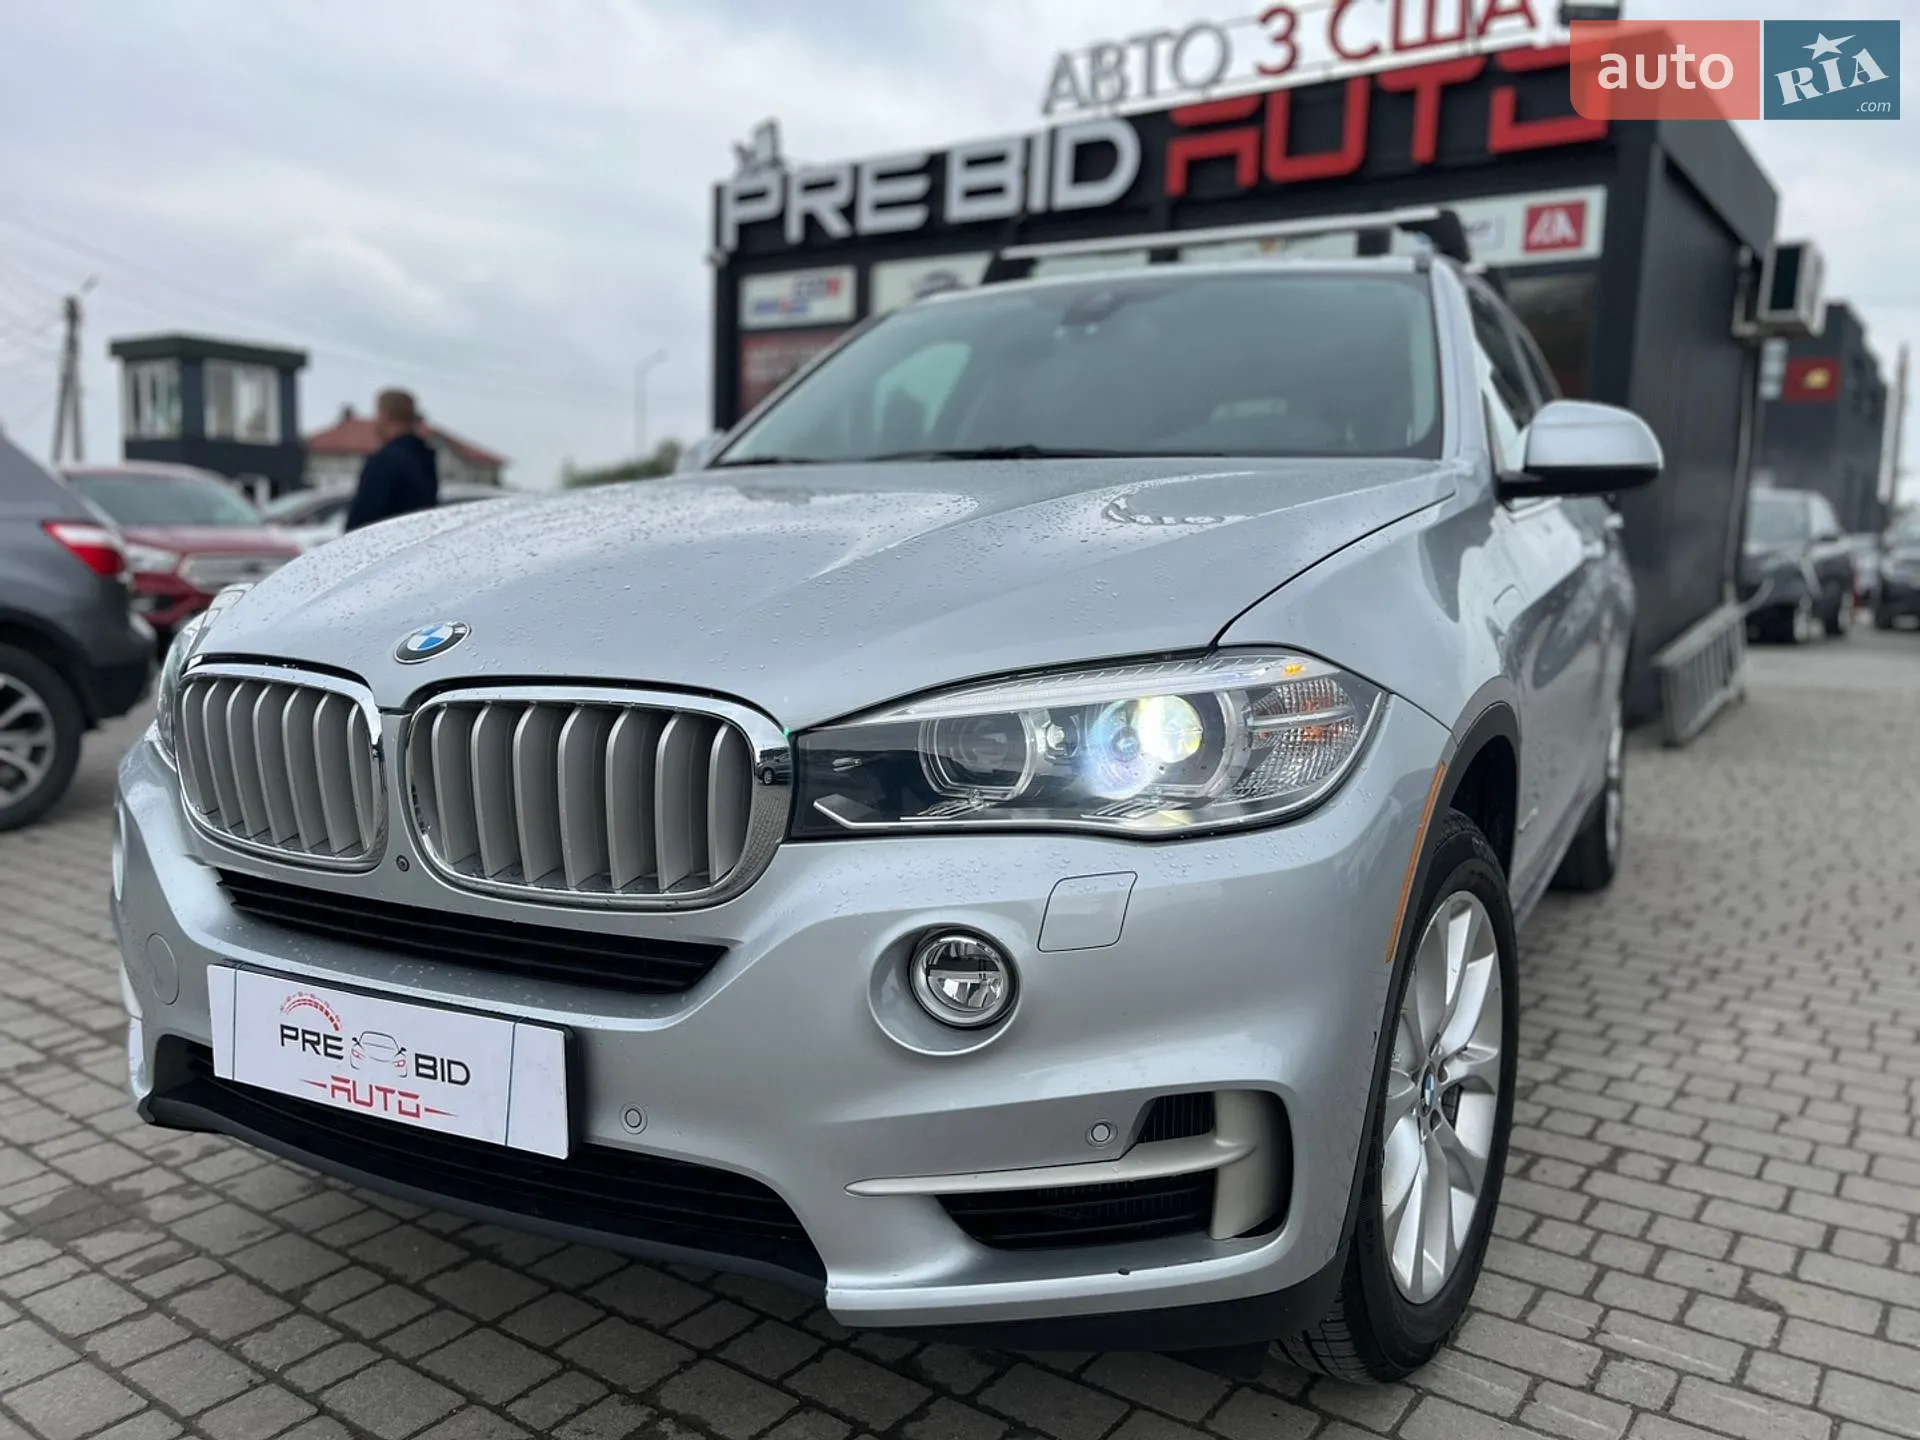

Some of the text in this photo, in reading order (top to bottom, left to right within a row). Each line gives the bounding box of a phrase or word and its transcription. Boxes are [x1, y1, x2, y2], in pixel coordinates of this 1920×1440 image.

[1041, 22, 1233, 115] АВТО
[720, 40, 1611, 252] PRE BID AUTO
[280, 1024, 471, 1086] PRE BID
[330, 1075, 421, 1118] AUTO
